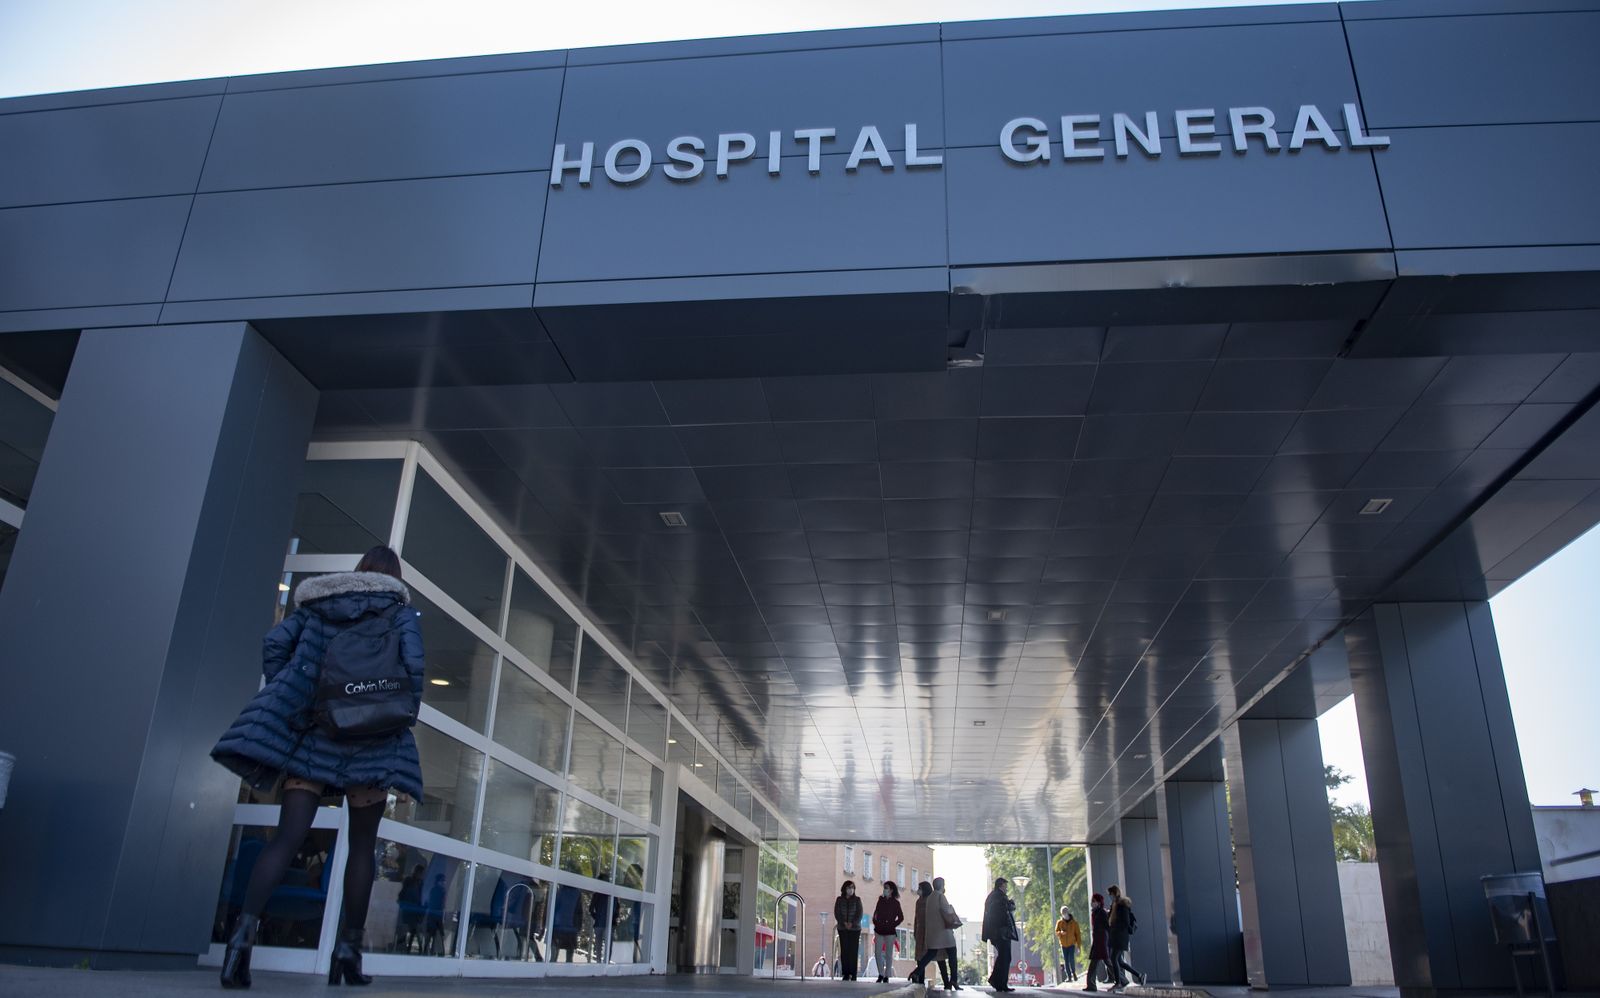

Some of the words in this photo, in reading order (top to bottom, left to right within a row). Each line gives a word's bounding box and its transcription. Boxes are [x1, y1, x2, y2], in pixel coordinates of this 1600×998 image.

[550, 123, 943, 187] HOSPITAL
[999, 103, 1391, 163] GENERAL
[345, 681, 377, 694] Calvin
[379, 680, 400, 690] Klein
